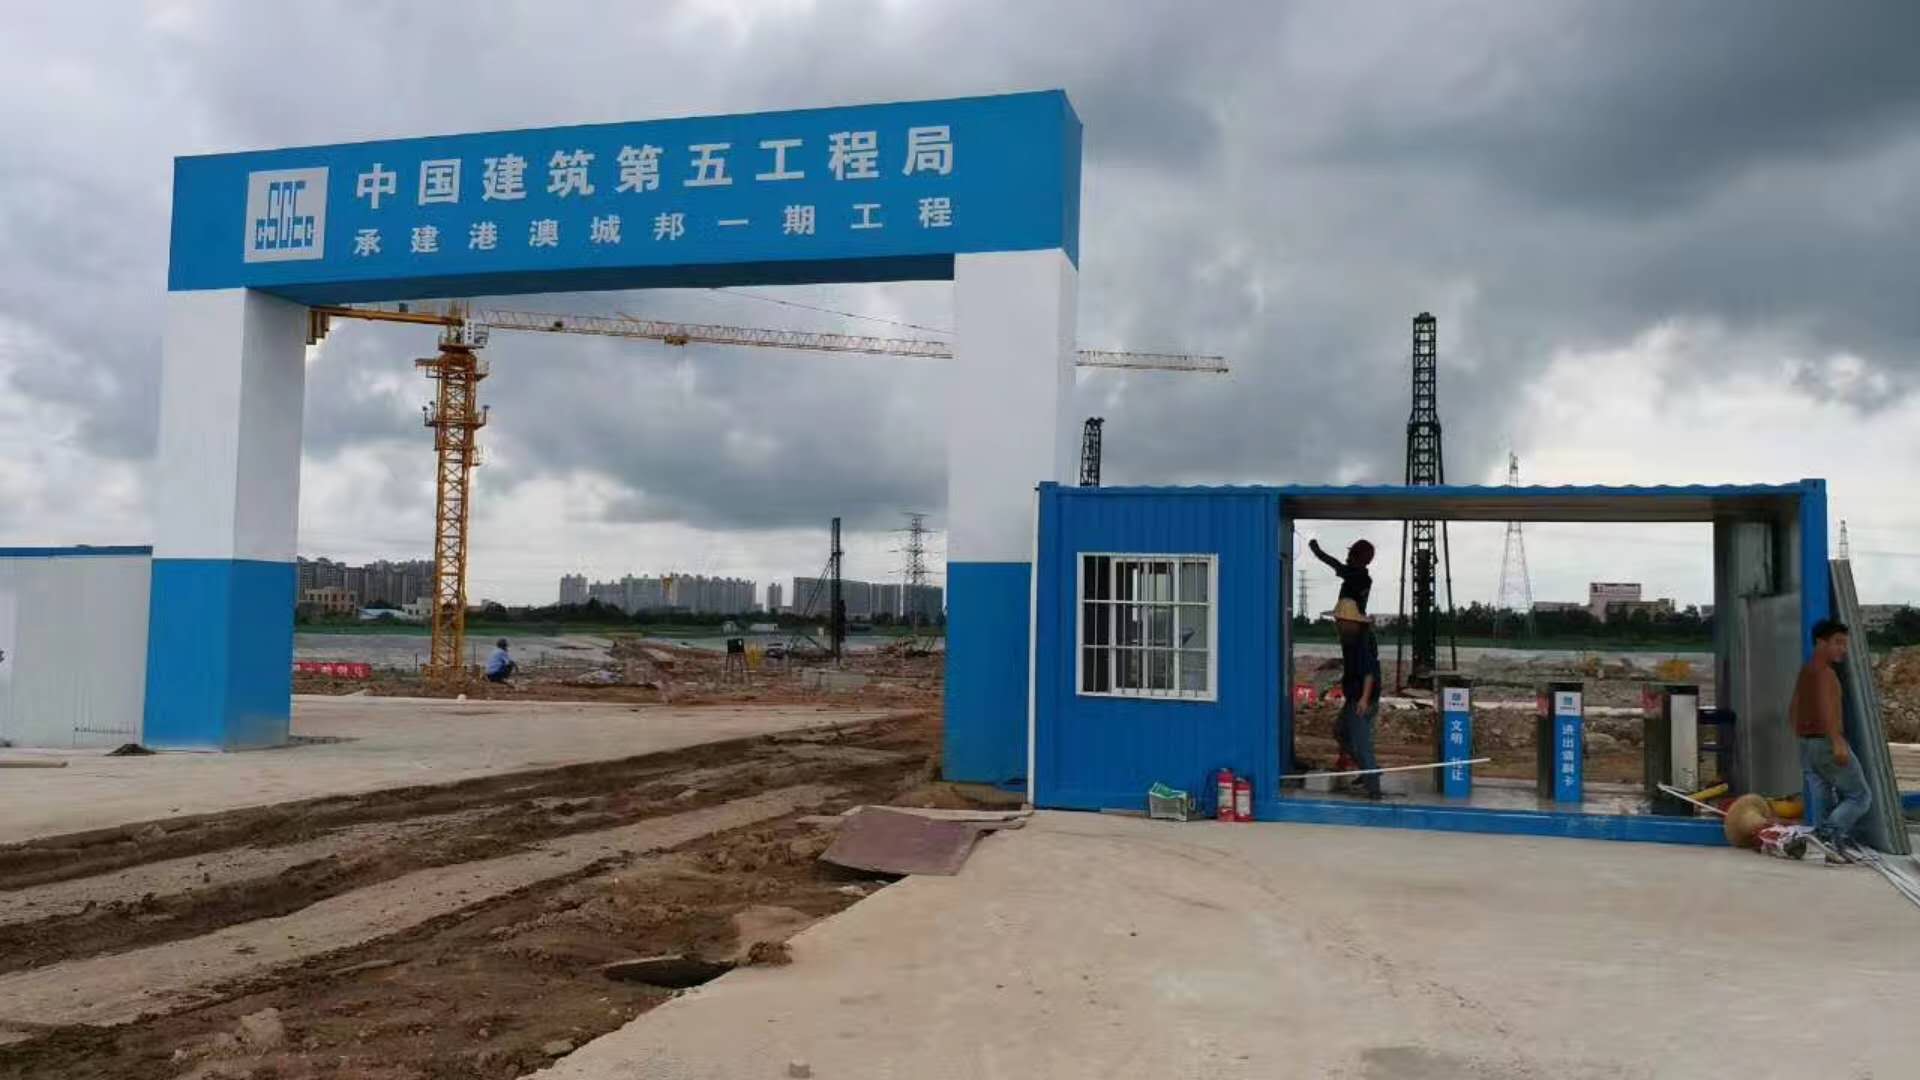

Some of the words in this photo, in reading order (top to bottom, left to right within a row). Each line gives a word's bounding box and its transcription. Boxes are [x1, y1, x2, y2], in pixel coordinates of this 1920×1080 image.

[356, 125, 954, 208] 中国建筑第五工程局
[354, 197, 953, 256] 承建港澳城邦一期工程
